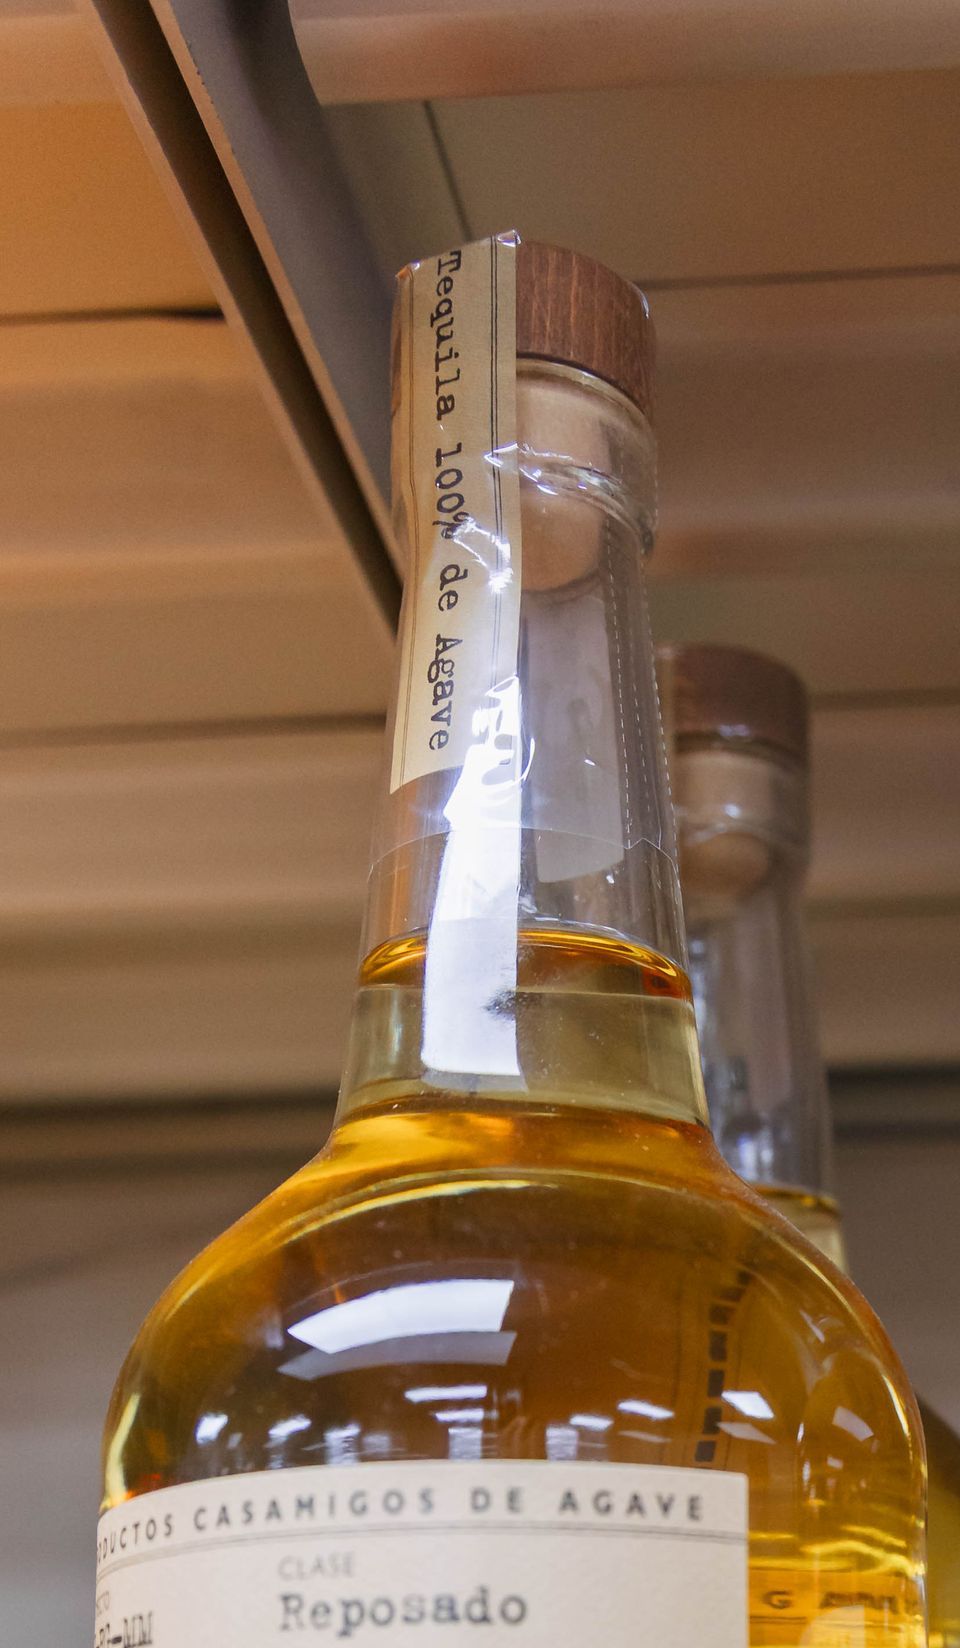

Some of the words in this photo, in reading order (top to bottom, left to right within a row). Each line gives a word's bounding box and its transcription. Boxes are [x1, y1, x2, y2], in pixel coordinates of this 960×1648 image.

[430, 250, 462, 422] Tequila
[438, 562, 469, 612] de
[427, 633, 463, 753] Agave
[194, 1488, 436, 1532] CASAMIGOS
[472, 1487, 525, 1514] DE
[560, 1490, 705, 1523] AGAVE
[278, 1552, 356, 1581] CLASE
[278, 1591, 529, 1638] Reposado
